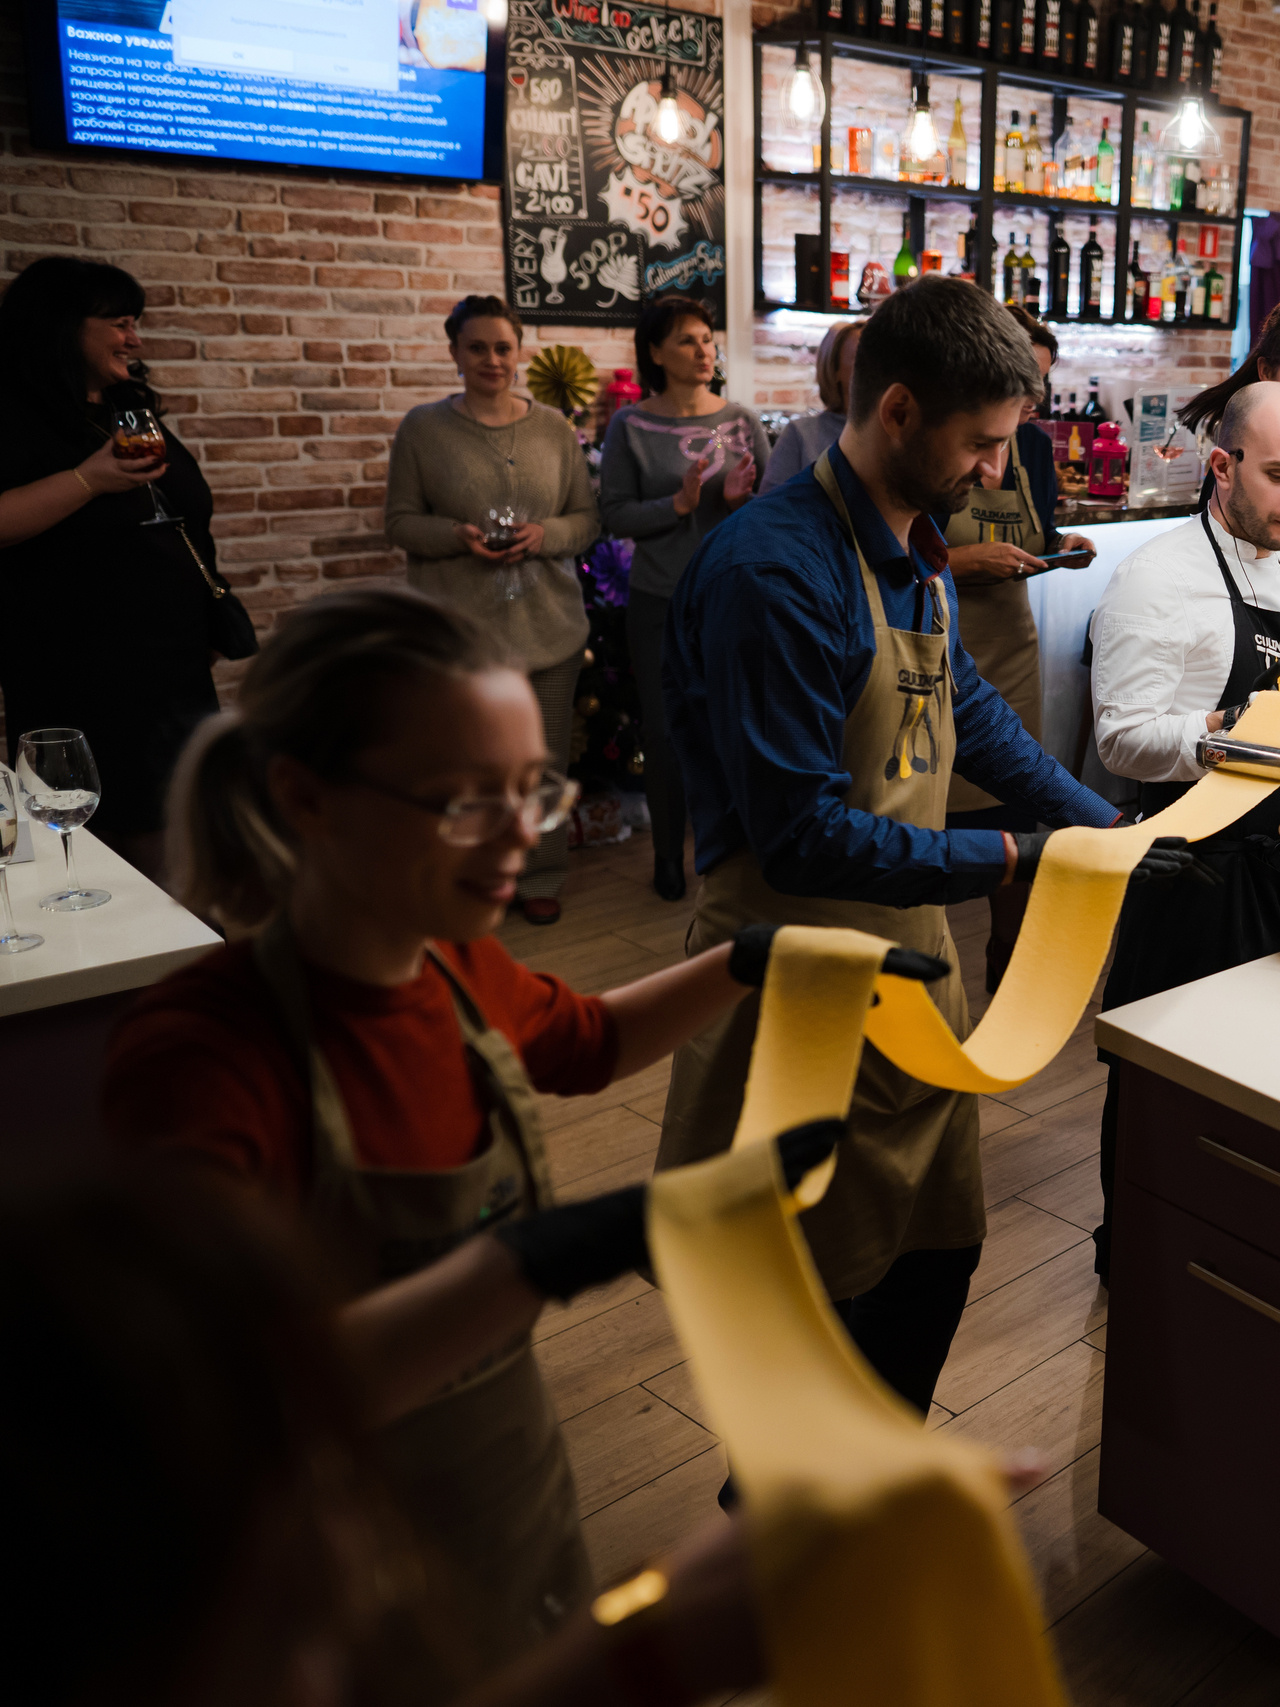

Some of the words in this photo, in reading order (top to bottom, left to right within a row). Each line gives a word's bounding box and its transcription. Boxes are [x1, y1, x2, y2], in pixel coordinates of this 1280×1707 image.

[67, 25, 122, 44] Важное
[68, 48, 124, 65] Невзирая
[127, 58, 142, 68] на
[145, 60, 161, 69] тот
[69, 65, 122, 79] запросы
[124, 71, 140, 80] на
[141, 73, 186, 86] особое
[188, 79, 222, 90] меню
[223, 82, 241, 92] для
[71, 78, 125, 91] пищевой
[263, 99, 277, 109] не
[72, 91, 125, 105] изоляции
[127, 97, 140, 106] от
[72, 102, 95, 114] Это
[97, 105, 173, 122] обусловлено
[73, 117, 125, 130] рабочей
[127, 122, 168, 135] среде,
[73, 131, 125, 143] другими
[513, 227, 540, 308] EVERY
